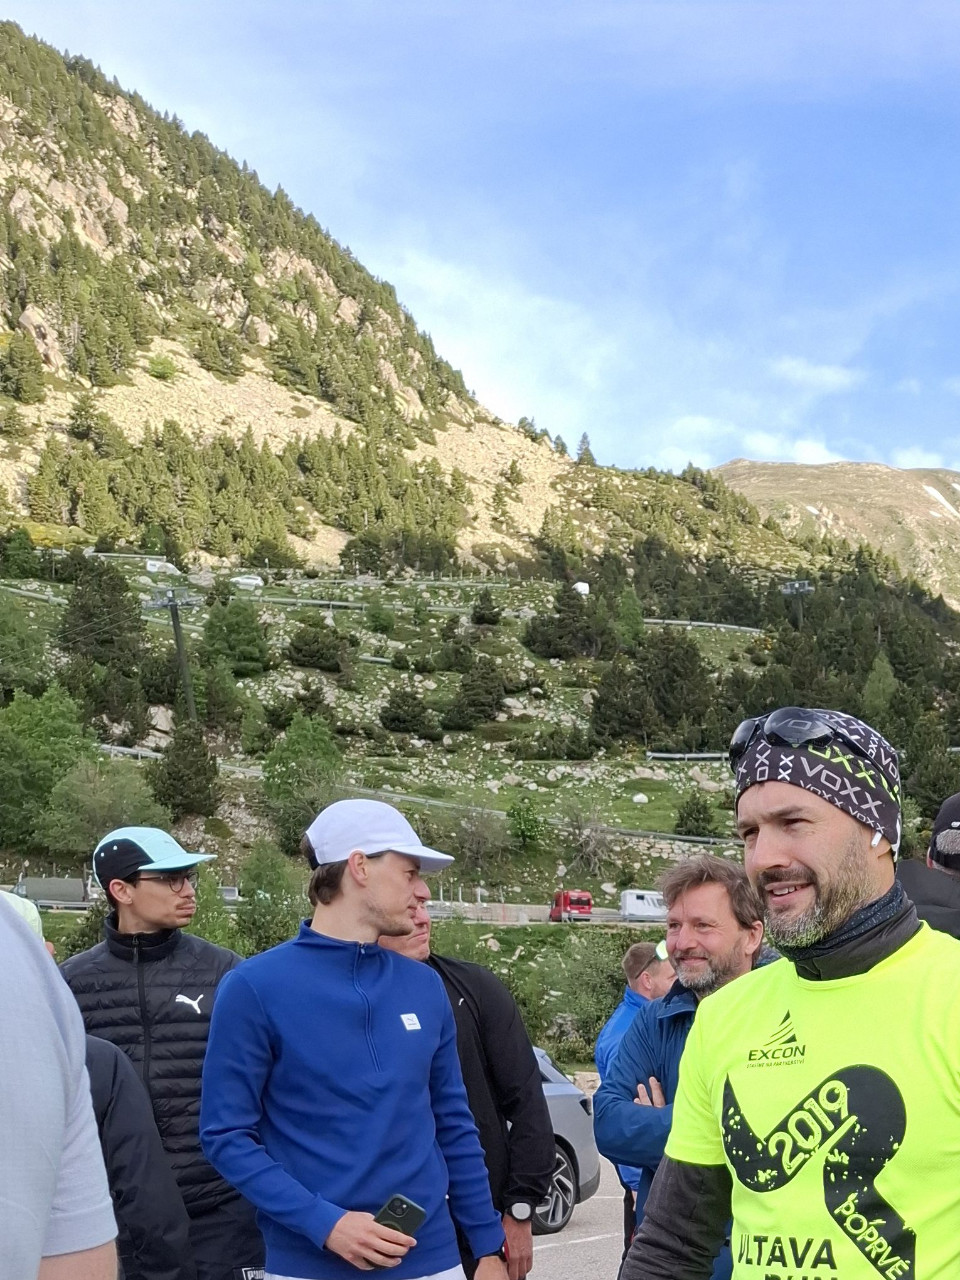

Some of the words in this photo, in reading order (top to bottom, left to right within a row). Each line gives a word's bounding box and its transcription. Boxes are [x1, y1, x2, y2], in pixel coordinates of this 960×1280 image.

[800, 756, 882, 819] VOXX
[848, 806, 885, 834] VOXX
[748, 1045, 806, 1061] EXCON
[768, 1079, 851, 1176] 2019
[738, 1233, 838, 1270] VLTAVA
